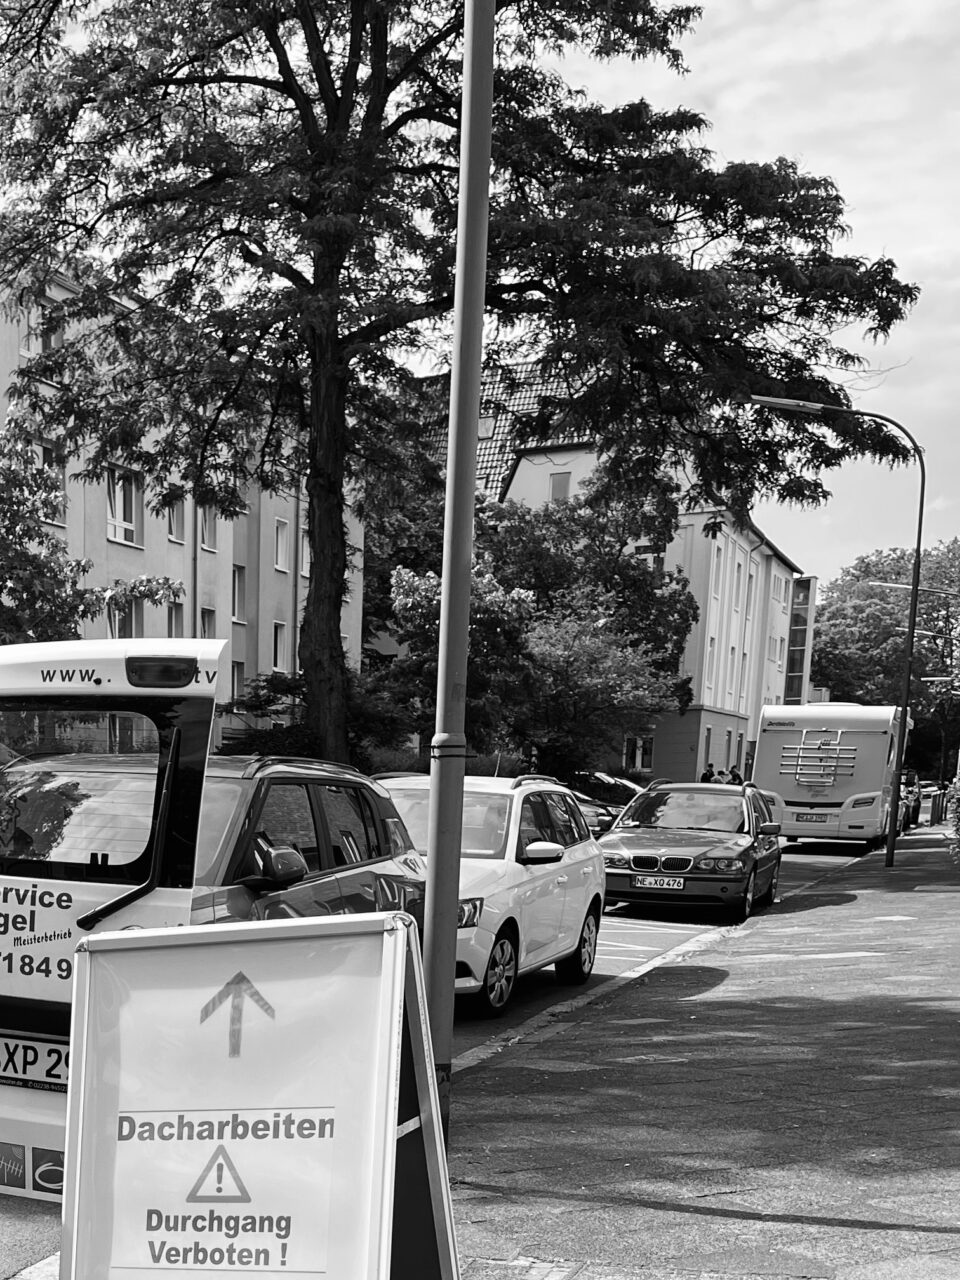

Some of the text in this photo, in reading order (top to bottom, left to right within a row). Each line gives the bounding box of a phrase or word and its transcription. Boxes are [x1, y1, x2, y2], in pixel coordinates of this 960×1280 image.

[13, 928, 72, 948] Meisterbetrieb
[117, 1112, 335, 1141] Dacharbeiten
[146, 1208, 292, 1239] Durchgang
[148, 1240, 270, 1266] Verboten
